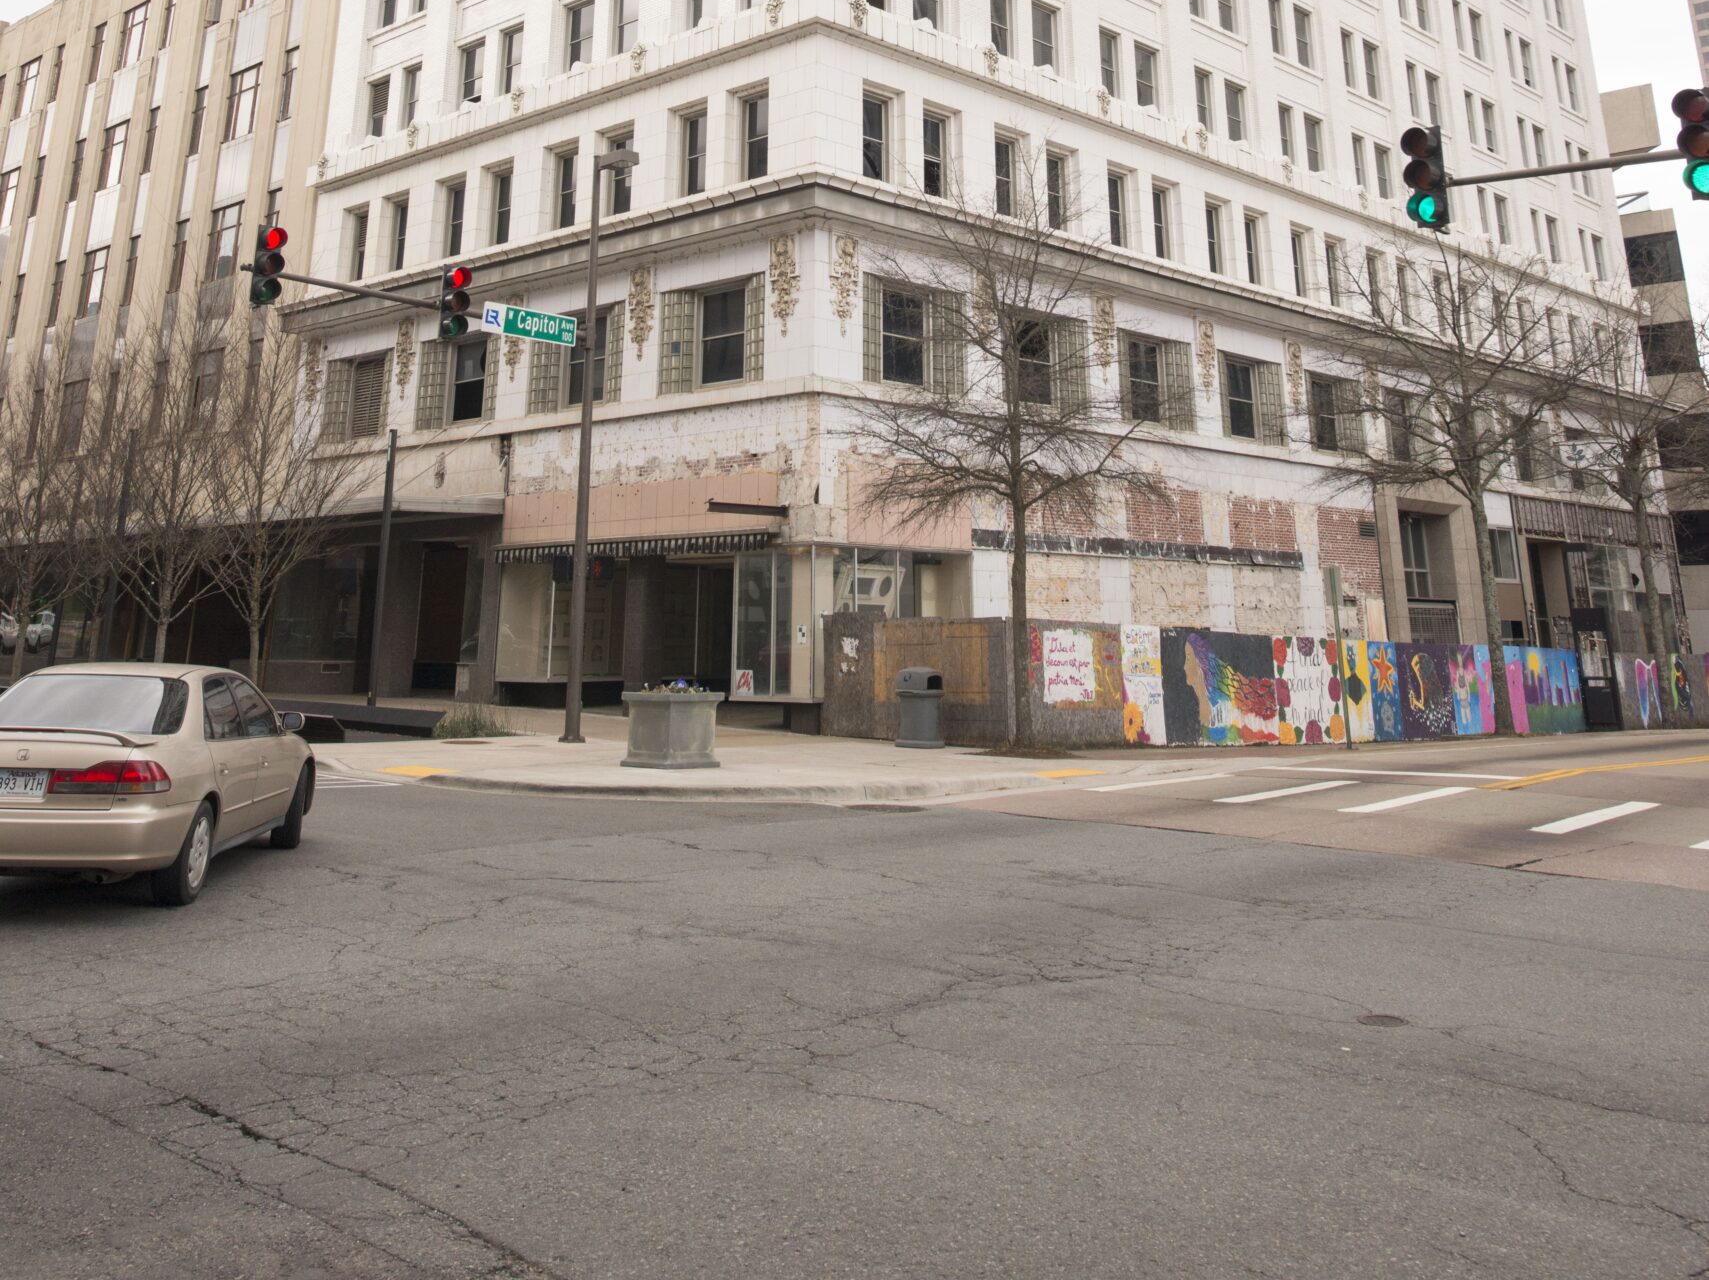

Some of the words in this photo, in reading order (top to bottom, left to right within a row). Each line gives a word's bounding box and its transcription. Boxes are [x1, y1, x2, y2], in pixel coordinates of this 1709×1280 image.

[508, 310, 514, 320] W
[517, 311, 559, 336] Capitol
[561, 320, 574, 331] Ave
[561, 331, 573, 342] 100
[24, 777, 45, 791] VIH
